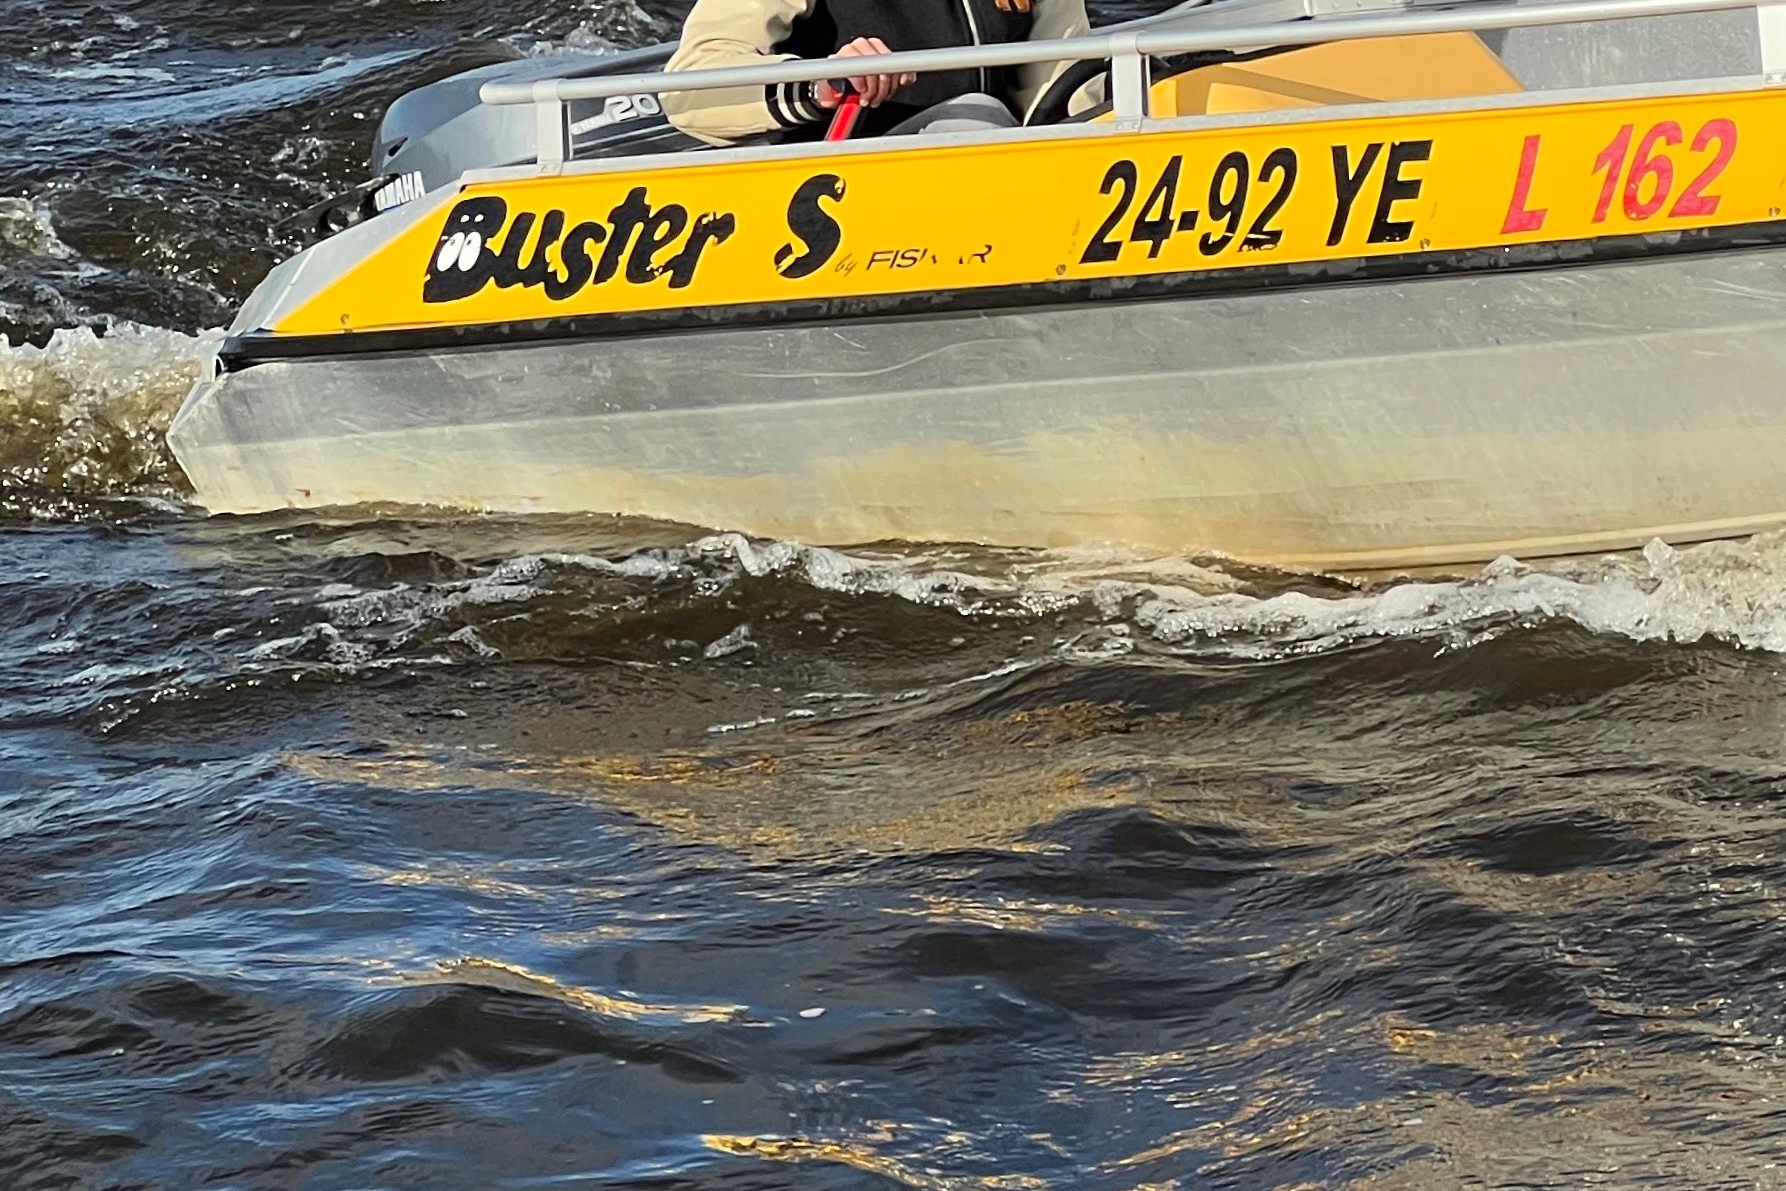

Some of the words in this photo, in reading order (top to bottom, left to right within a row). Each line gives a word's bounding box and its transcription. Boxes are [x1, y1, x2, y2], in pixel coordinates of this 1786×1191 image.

[604, 93, 661, 122] 20
[1079, 147, 1298, 264] 24-92
[1326, 139, 1433, 247] YE
[1500, 134, 1549, 236] L
[1592, 118, 1738, 224] 162
[422, 186, 736, 304] Buster
[774, 173, 847, 279] S
